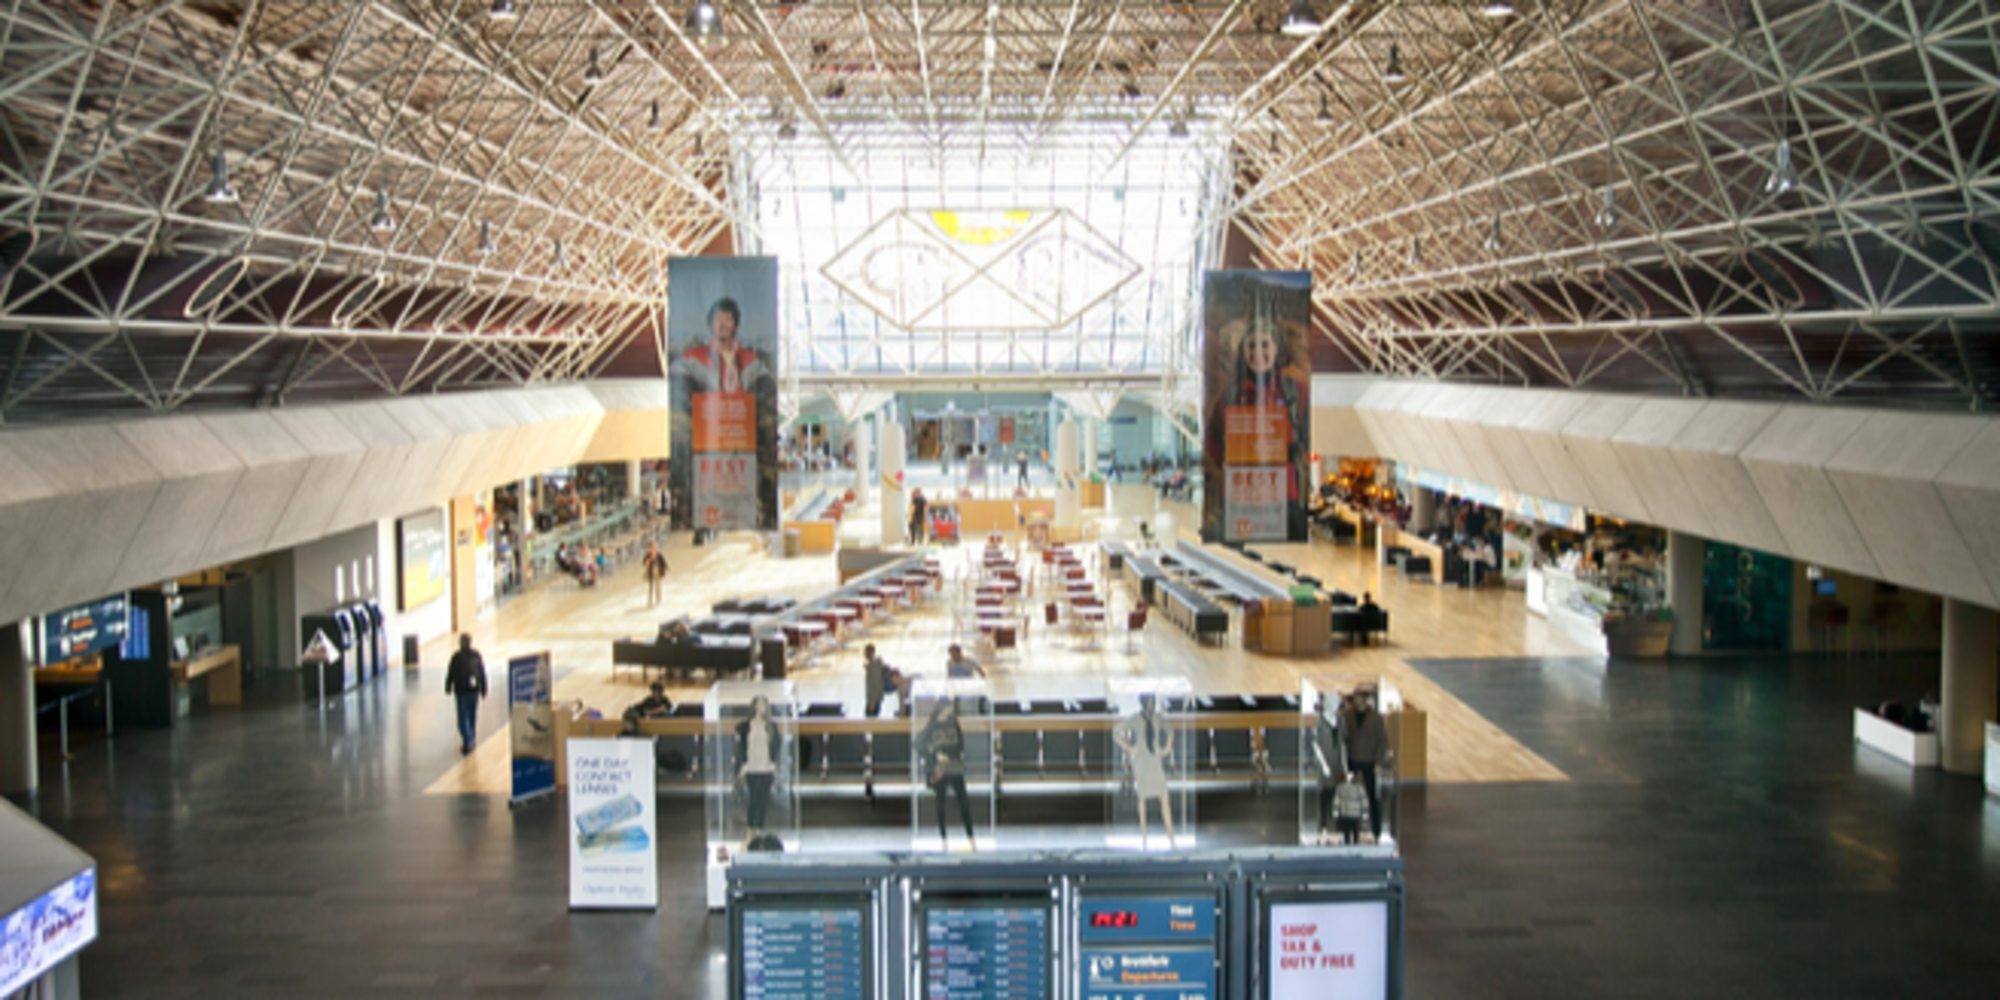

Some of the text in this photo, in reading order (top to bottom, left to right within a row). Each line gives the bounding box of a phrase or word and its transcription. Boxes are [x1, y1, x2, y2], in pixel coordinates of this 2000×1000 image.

[1232, 471, 1279, 487] BEST
[576, 757, 600, 768] ONE
[575, 770, 632, 783] CONTACT
[576, 783, 618, 795] LENSES
[1281, 924, 1318, 937] SHOP
[1281, 940, 1323, 953] TAX &
[1280, 954, 1355, 970] DUTY FREE
